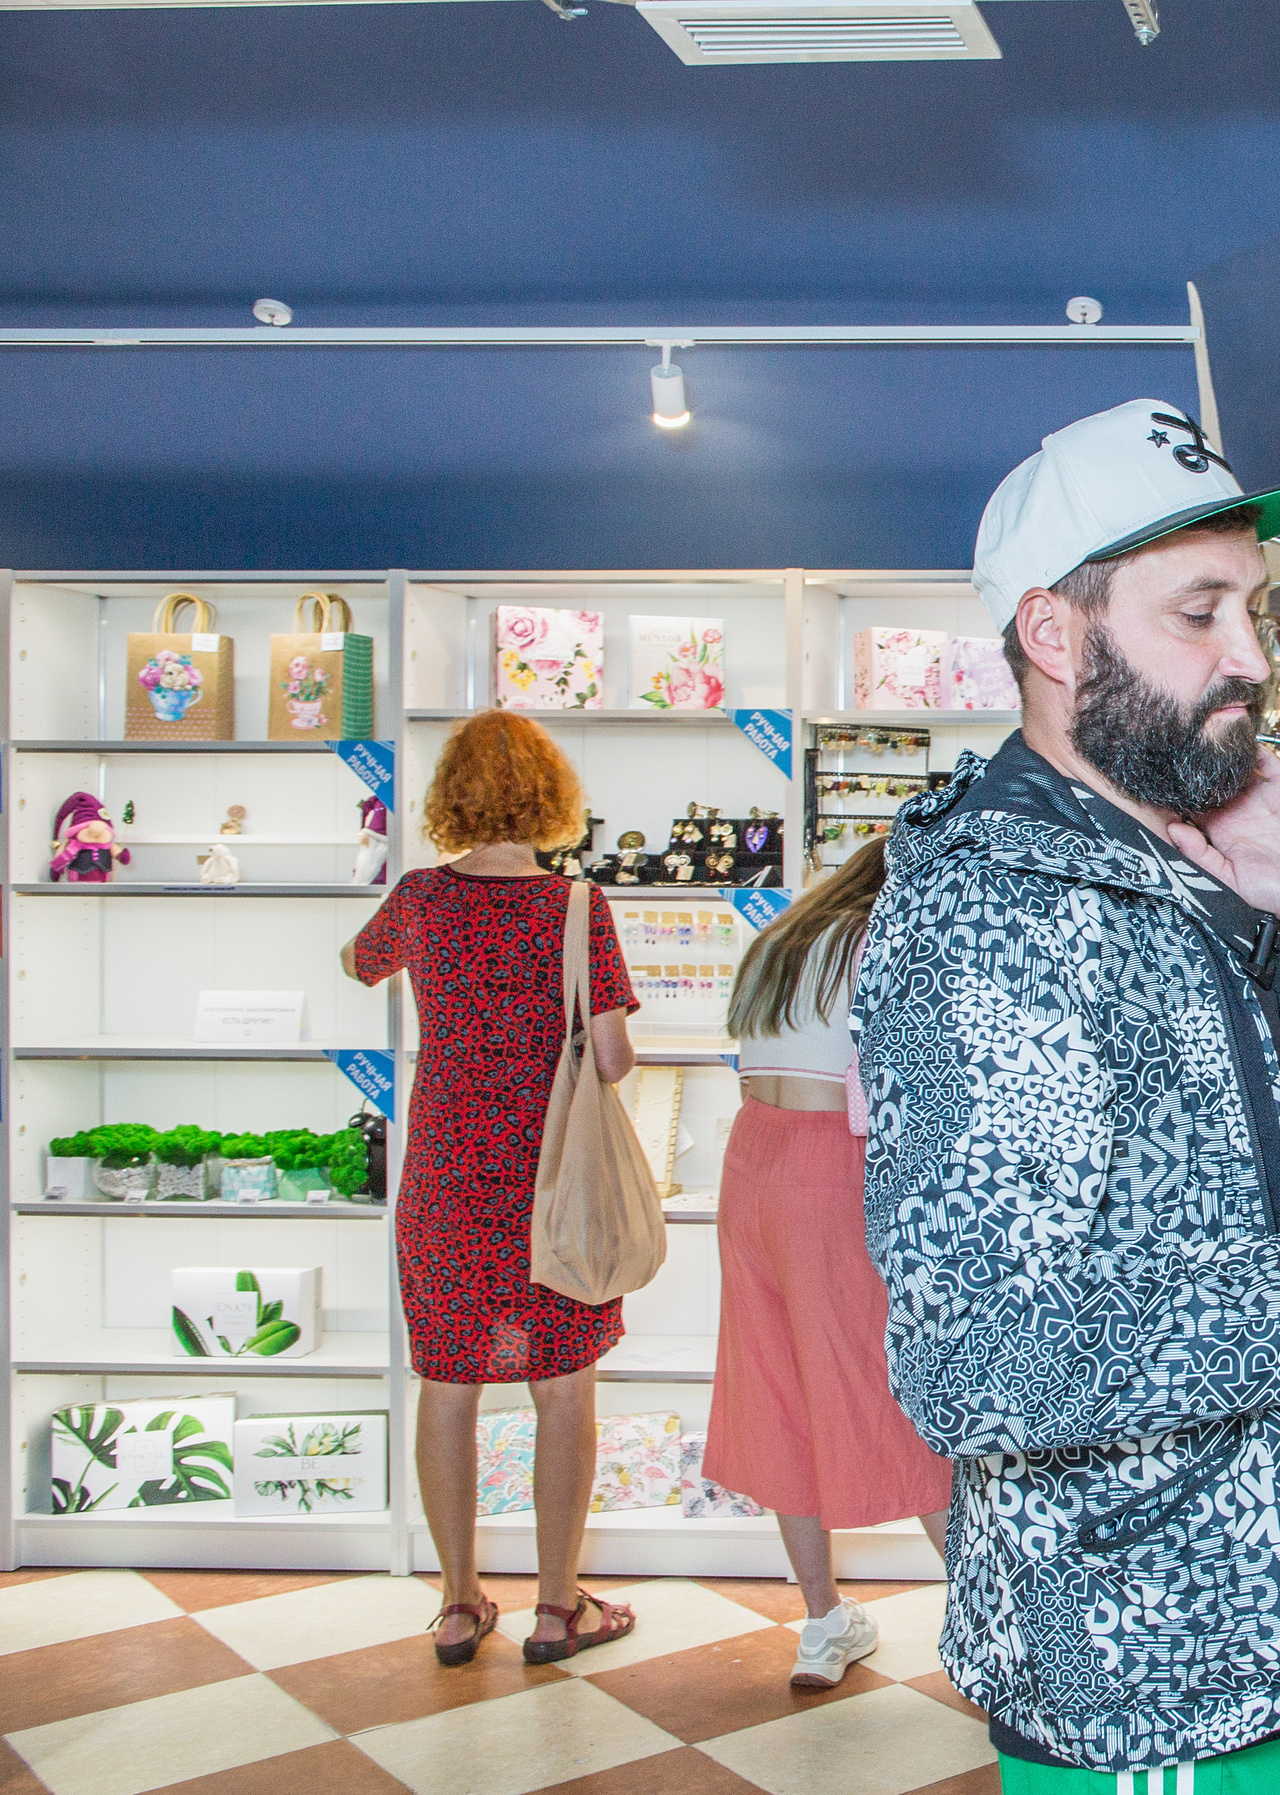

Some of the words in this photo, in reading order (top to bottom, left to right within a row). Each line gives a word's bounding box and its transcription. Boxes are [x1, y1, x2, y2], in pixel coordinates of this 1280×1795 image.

[743, 723, 778, 760] РАБОТА
[750, 711, 790, 752] РУЧНАЯ
[347, 755, 381, 791] РАБОТА
[353, 743, 392, 784] РУЧНАЯ
[742, 902, 768, 929] РАБО
[749, 891, 780, 921] РУЧН
[346, 1063, 380, 1099] РАБОТА
[353, 1052, 392, 1092] РУЧНАЯ
[217, 1302, 252, 1312] ENJOY
[300, 1457, 321, 1470] BE
